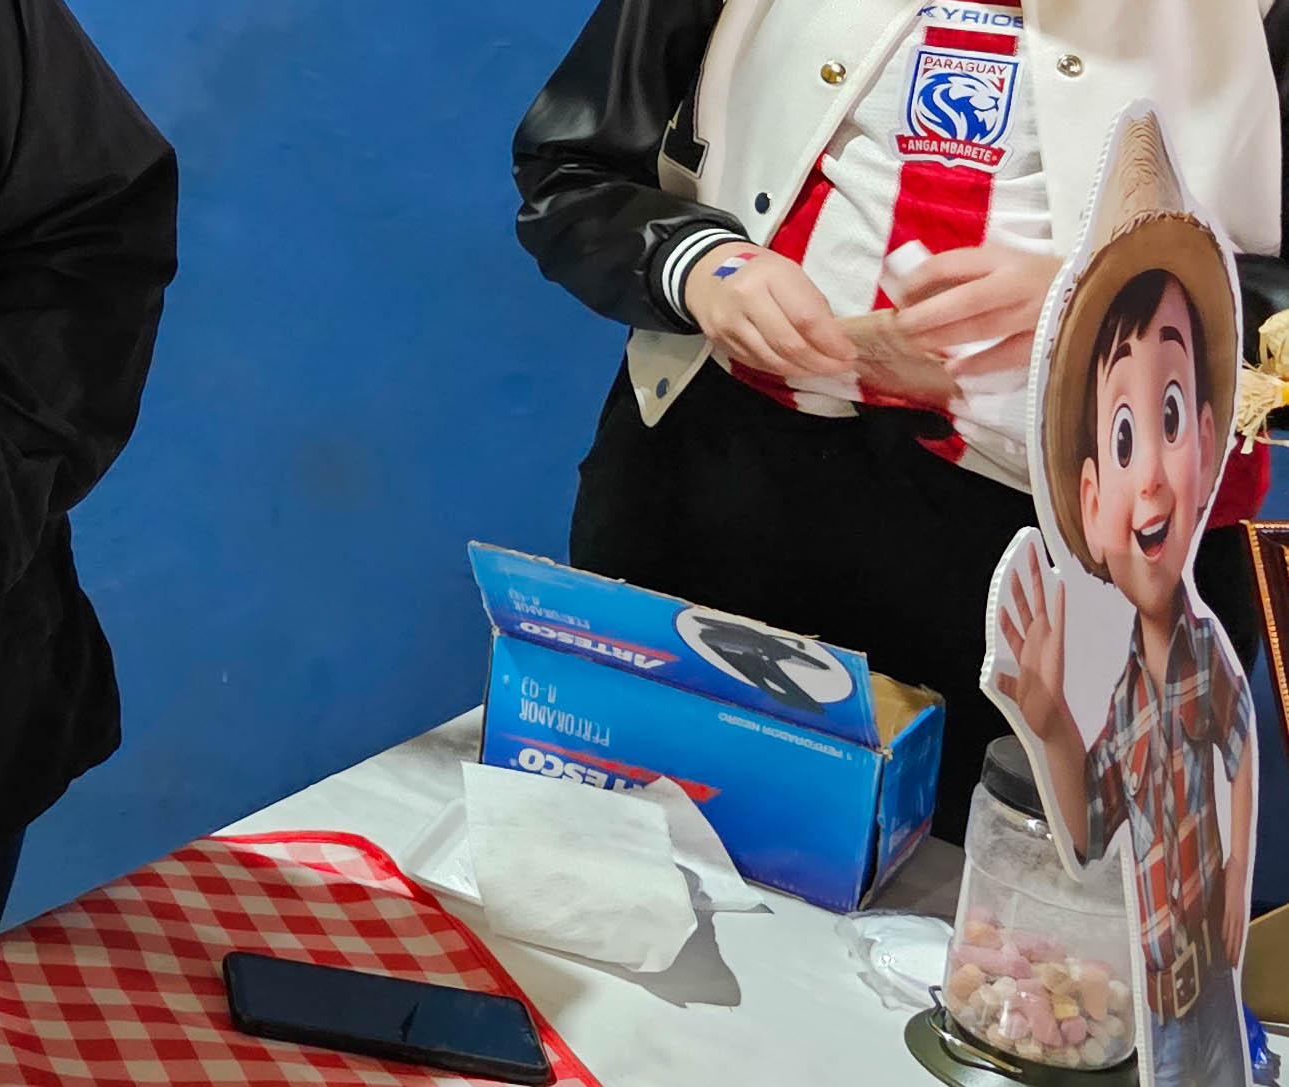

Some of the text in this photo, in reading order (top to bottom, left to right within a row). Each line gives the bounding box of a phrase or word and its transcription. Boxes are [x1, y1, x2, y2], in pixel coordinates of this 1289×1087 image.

[923, 56, 1007, 76] PARAGUAY
[907, 139, 993, 161] ANGA MBARETE
[519, 621, 666, 669] ARTESCO
[519, 697, 611, 747] PERFORADOR
